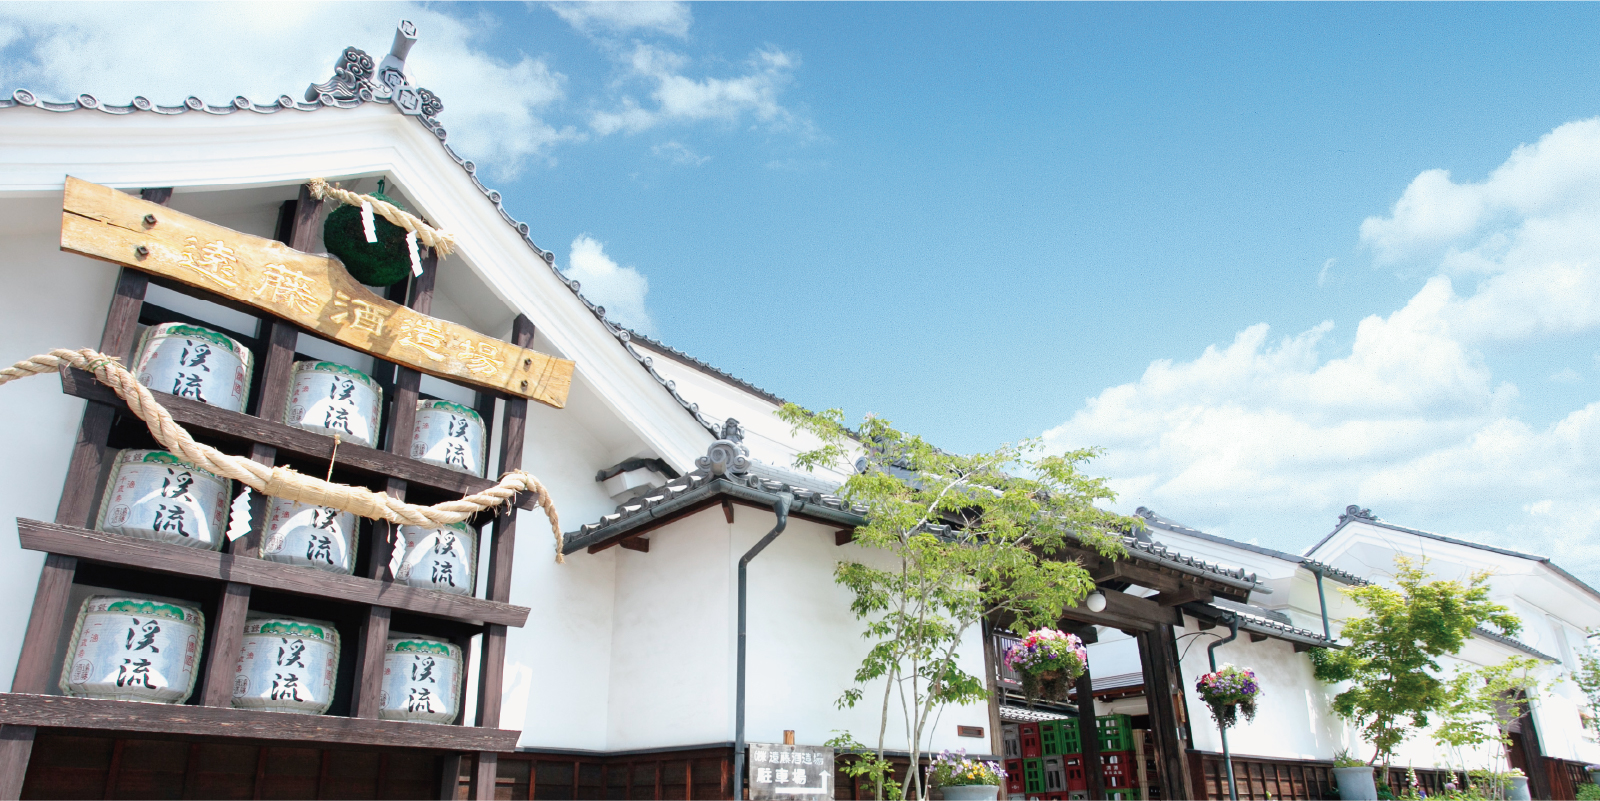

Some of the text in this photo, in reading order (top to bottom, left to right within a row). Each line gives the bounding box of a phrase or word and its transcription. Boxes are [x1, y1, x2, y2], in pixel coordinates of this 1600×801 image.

[178, 235, 504, 377] 遠藤酒造場
[756, 767, 807, 785] 駐車場
